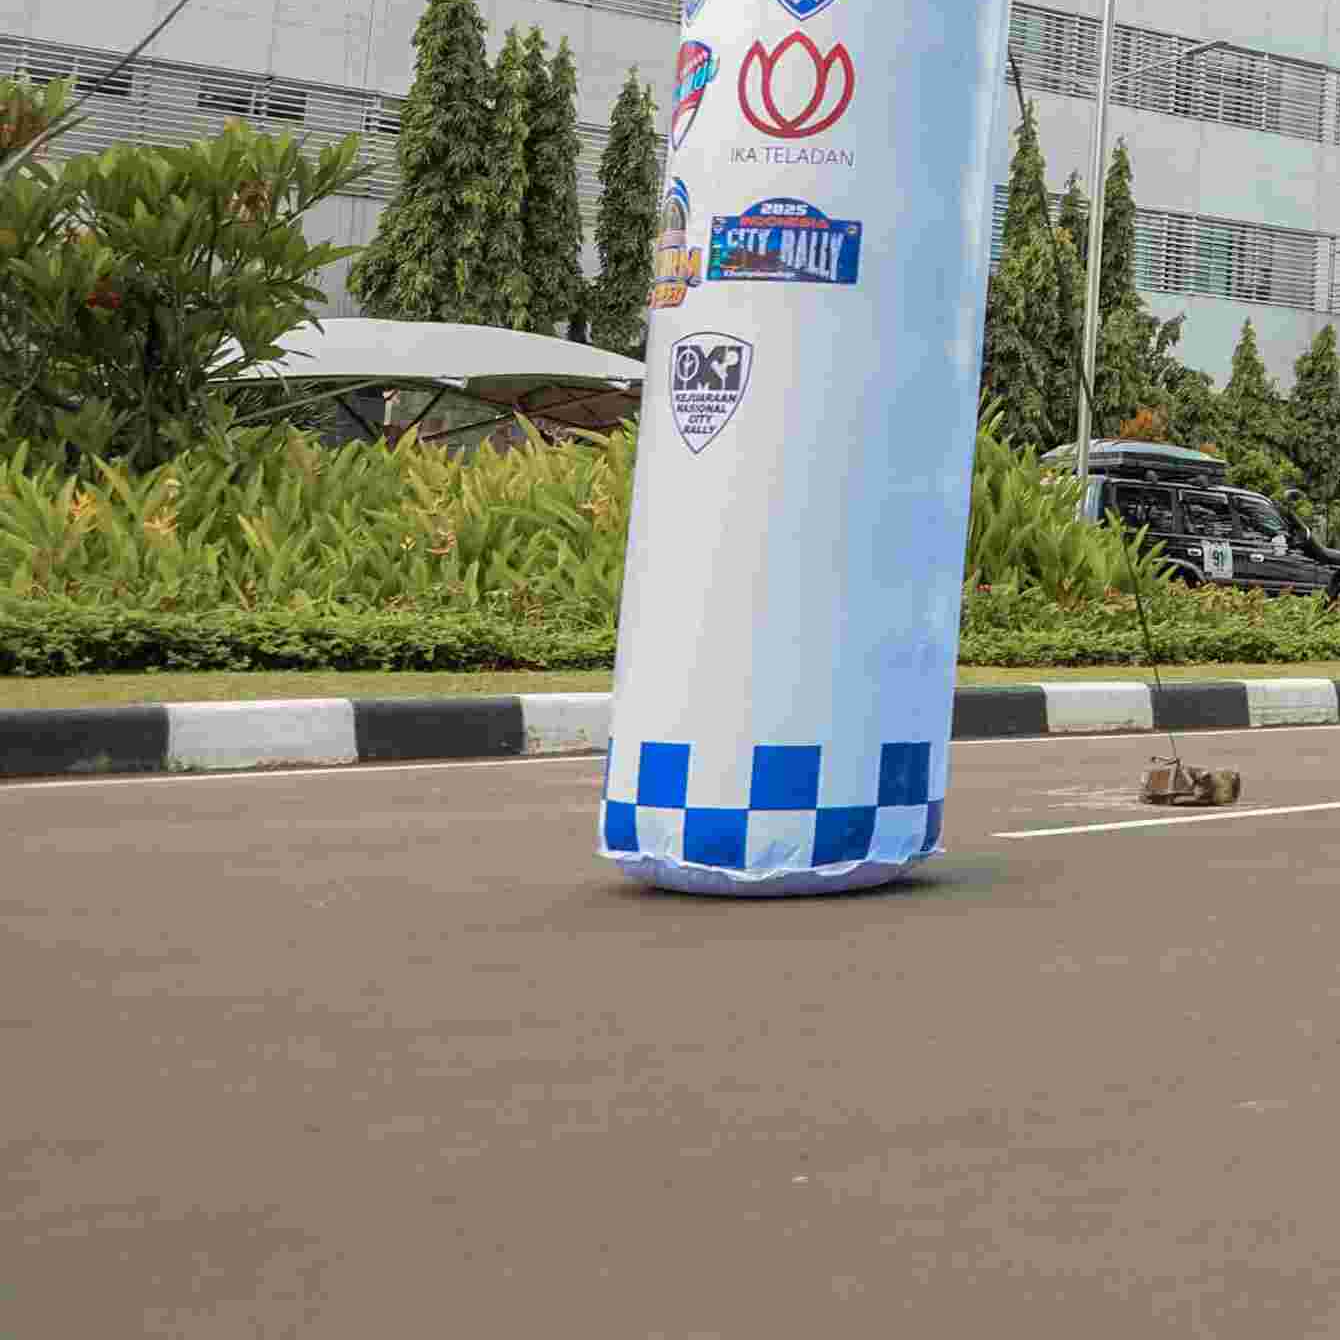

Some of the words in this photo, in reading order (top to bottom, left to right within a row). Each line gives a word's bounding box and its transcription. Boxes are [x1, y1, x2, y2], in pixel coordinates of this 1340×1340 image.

[728, 148, 757, 164] IKA
[763, 148, 855, 167] TELADAN
[760, 203, 808, 215] 2025
[728, 229, 770, 256] CITY
[782, 229, 844, 280] RALLY
[688, 414, 713, 424] CITY
[684, 425, 716, 434] RALLY
